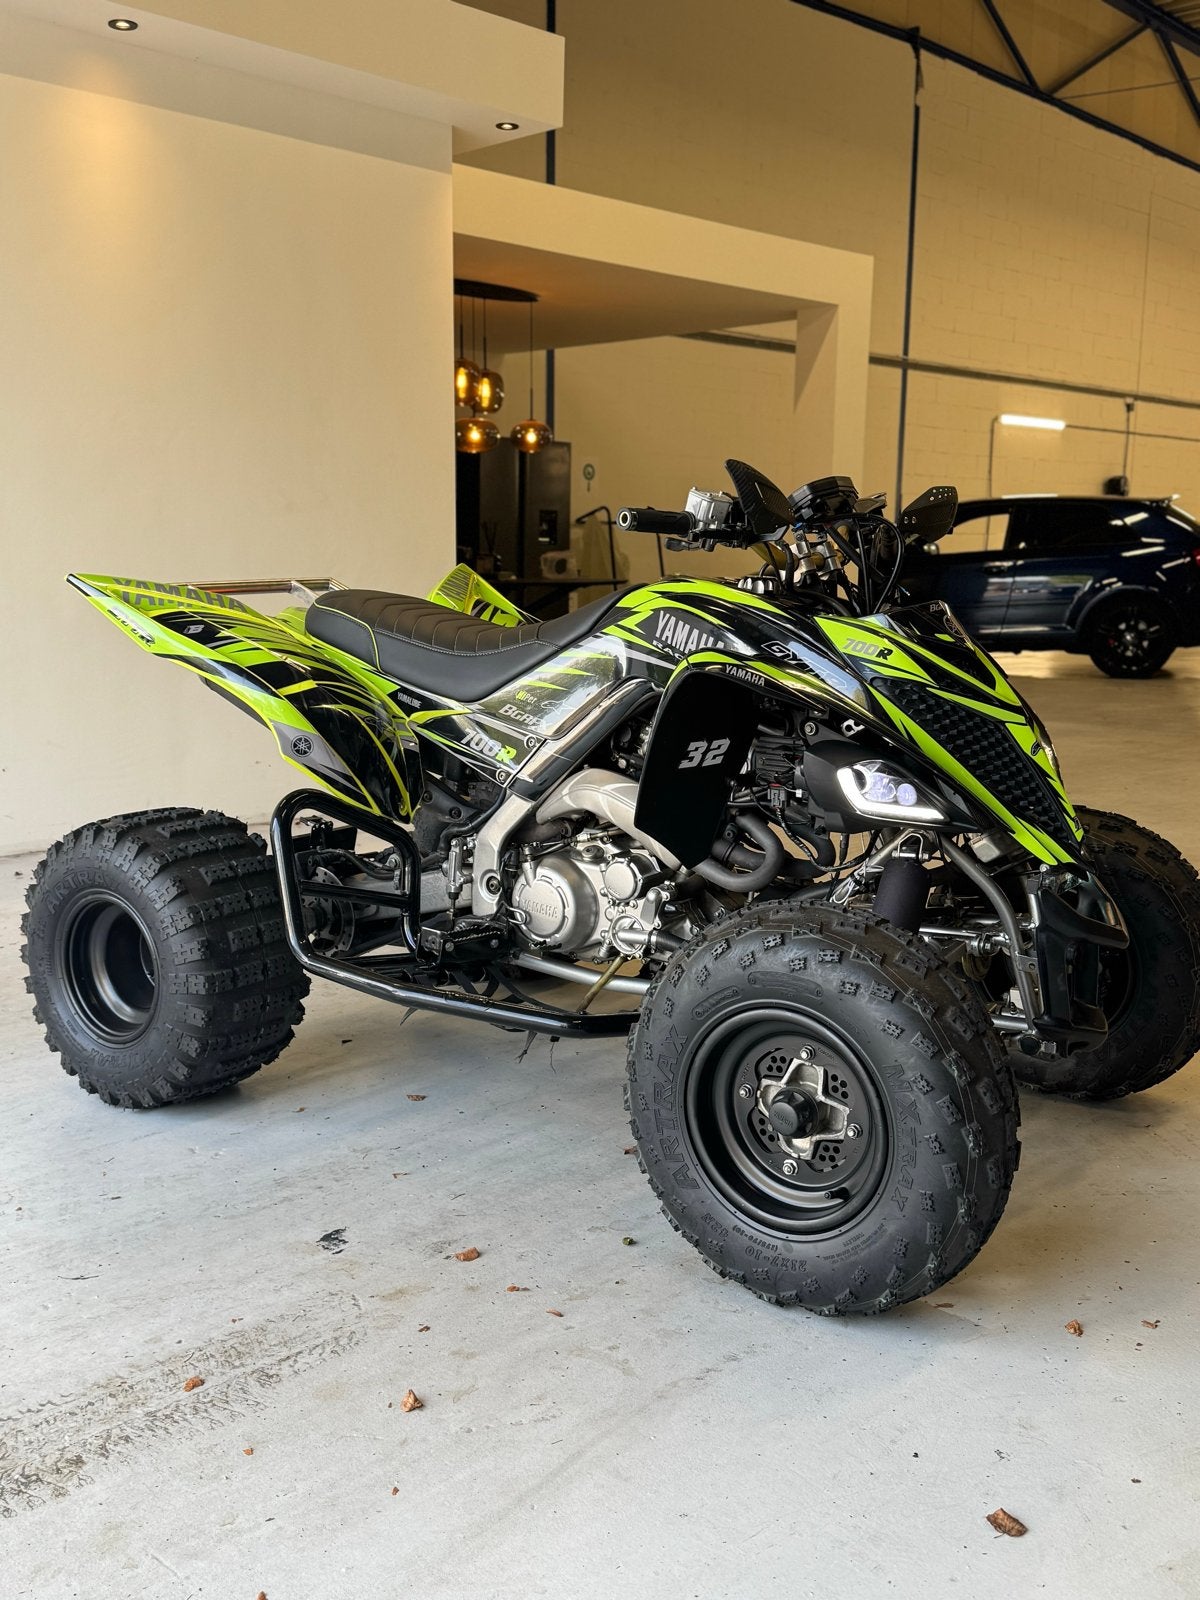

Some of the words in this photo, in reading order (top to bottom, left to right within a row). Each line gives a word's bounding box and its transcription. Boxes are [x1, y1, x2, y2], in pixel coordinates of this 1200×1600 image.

[656, 610, 725, 655] YAMAH
[842, 638, 893, 661] 700R
[725, 664, 766, 687] YAMAHA
[460, 727, 517, 764] 700R
[678, 737, 731, 769] 32
[654, 1024, 701, 1190] ARTRAX
